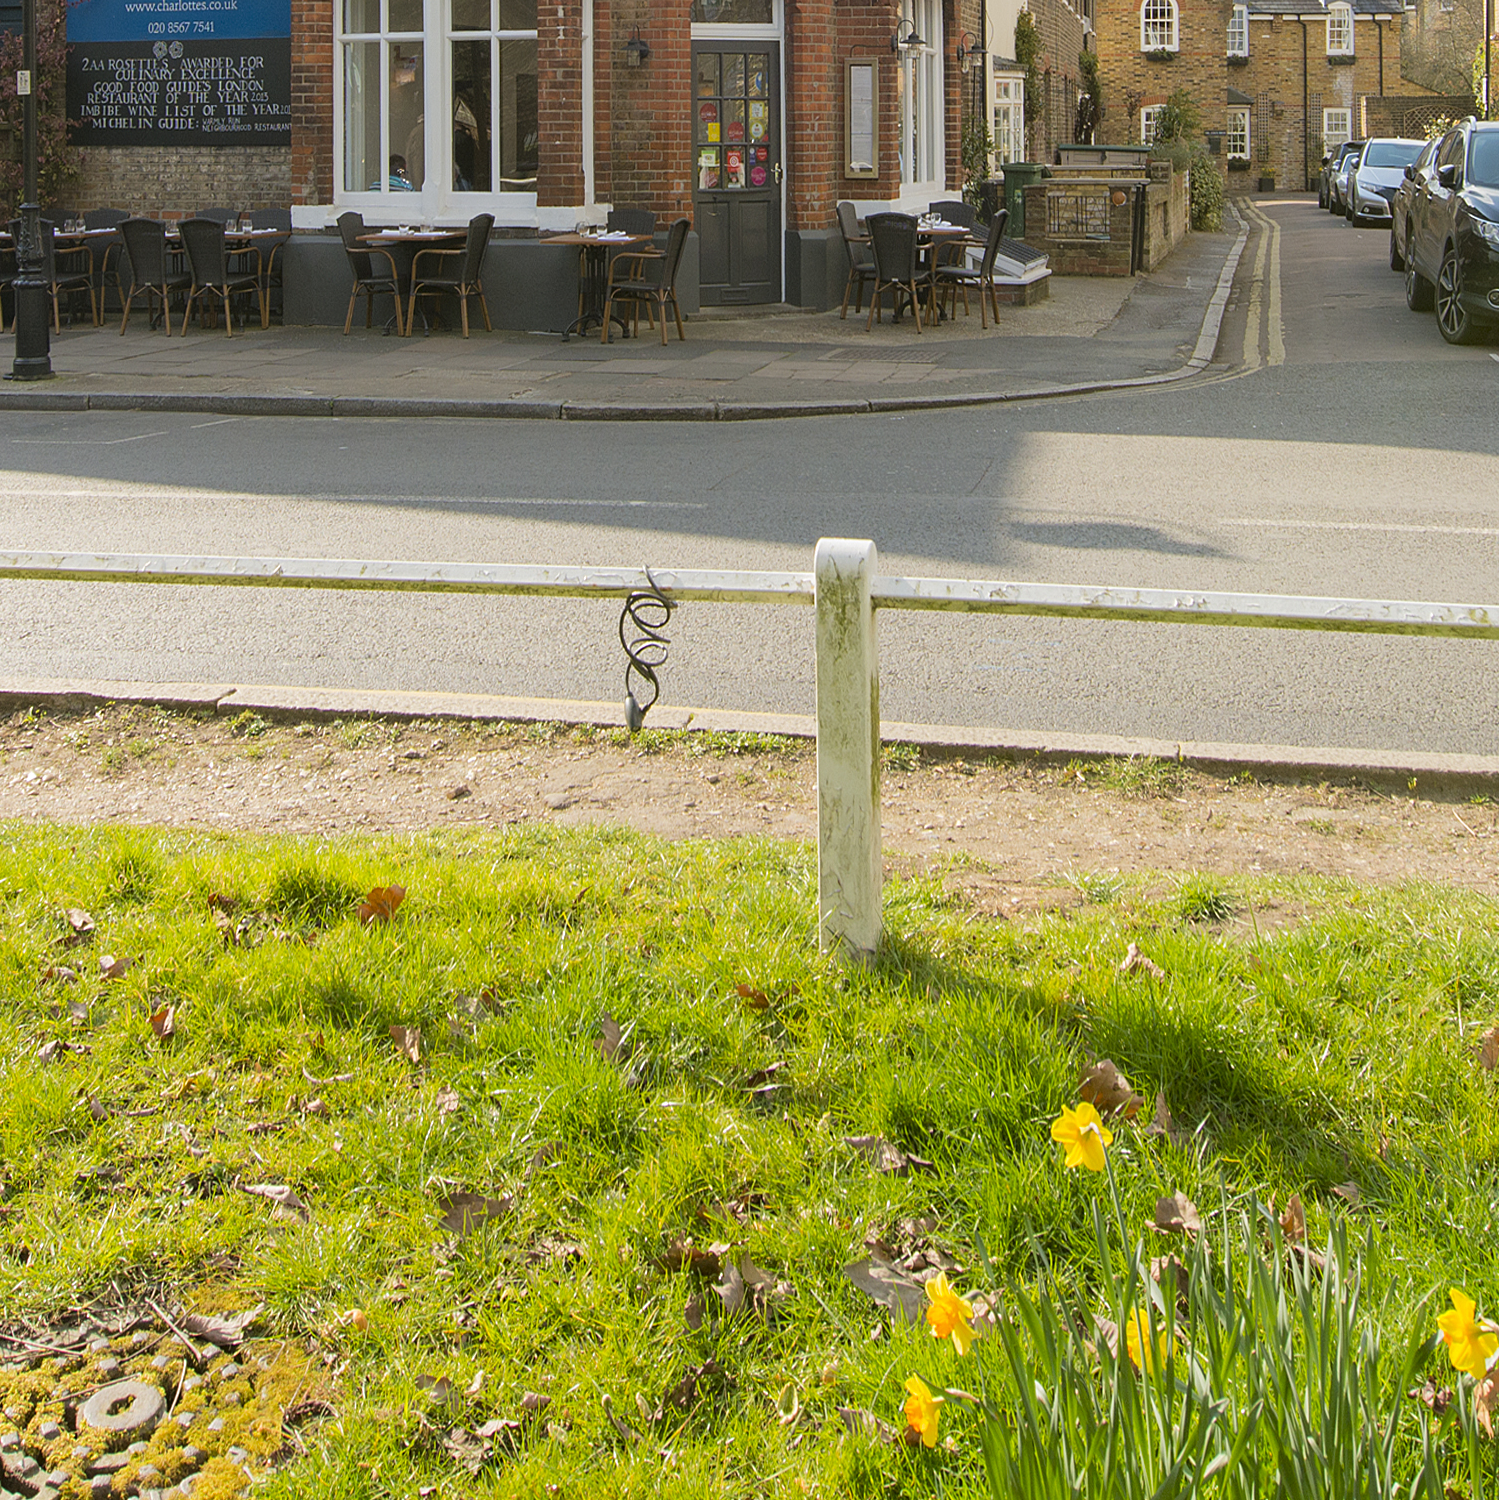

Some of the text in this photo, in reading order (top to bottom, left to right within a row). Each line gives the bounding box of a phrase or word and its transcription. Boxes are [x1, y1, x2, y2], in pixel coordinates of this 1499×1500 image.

[148, 21, 215, 34] 020 8567 7541
[180, 57, 233, 70] AWARDED
[240, 56, 264, 68] FOR
[115, 68, 256, 82] CULINARY EXCELLENCE
[94, 82, 123, 93] GOOD
[130, 81, 160, 93] FOOD
[218, 80, 264, 92] LONDON
[87, 92, 159, 104] RESTAURANT
[166, 92, 182, 104] OF
[188, 92, 210, 104] THE
[217, 92, 250, 103] YEAR
[80, 106, 122, 116] IMBIBE
[128, 105, 158, 116] WINE
[165, 106, 196, 117] LIST
[202, 105, 218, 116] OF
[224, 104, 247, 116] THE
[252, 104, 280, 115] YEAR
[92, 118, 200, 130] MICHELIN GUIDE:
